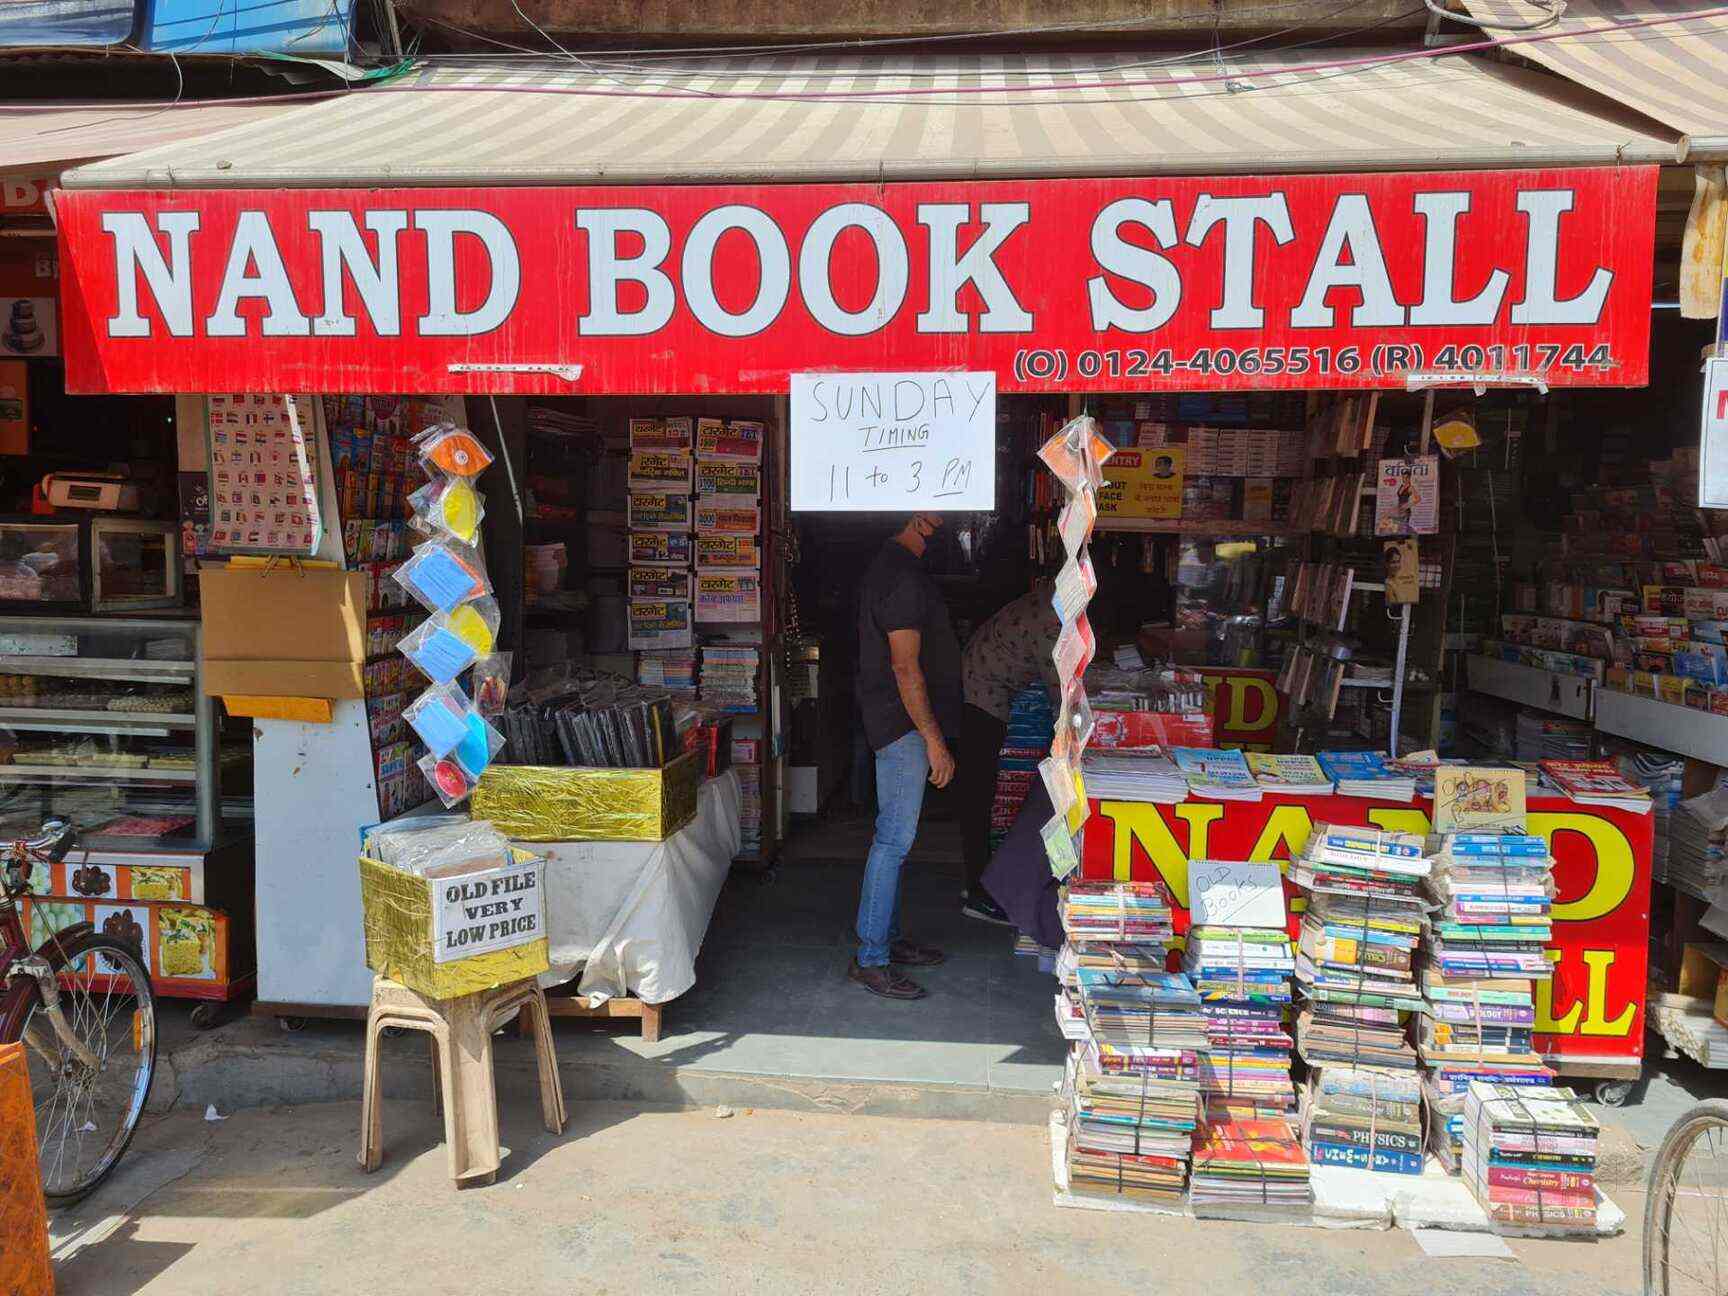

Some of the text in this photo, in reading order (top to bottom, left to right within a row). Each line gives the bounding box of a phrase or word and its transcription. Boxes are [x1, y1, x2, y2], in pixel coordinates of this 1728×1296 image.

[101, 190, 1614, 339] NAND BOOK STALL
[1014, 343, 1612, 382] (O) 0124-4065516 (R) 4011744
[810, 379, 991, 422] SUNDAY
[857, 423, 931, 447] TIMING
[830, 458, 972, 502] 11 to 3 PM
[446, 871, 536, 903] OLD FILE
[465, 897, 524, 920] VERY
[446, 914, 536, 949] LOW PRICE
